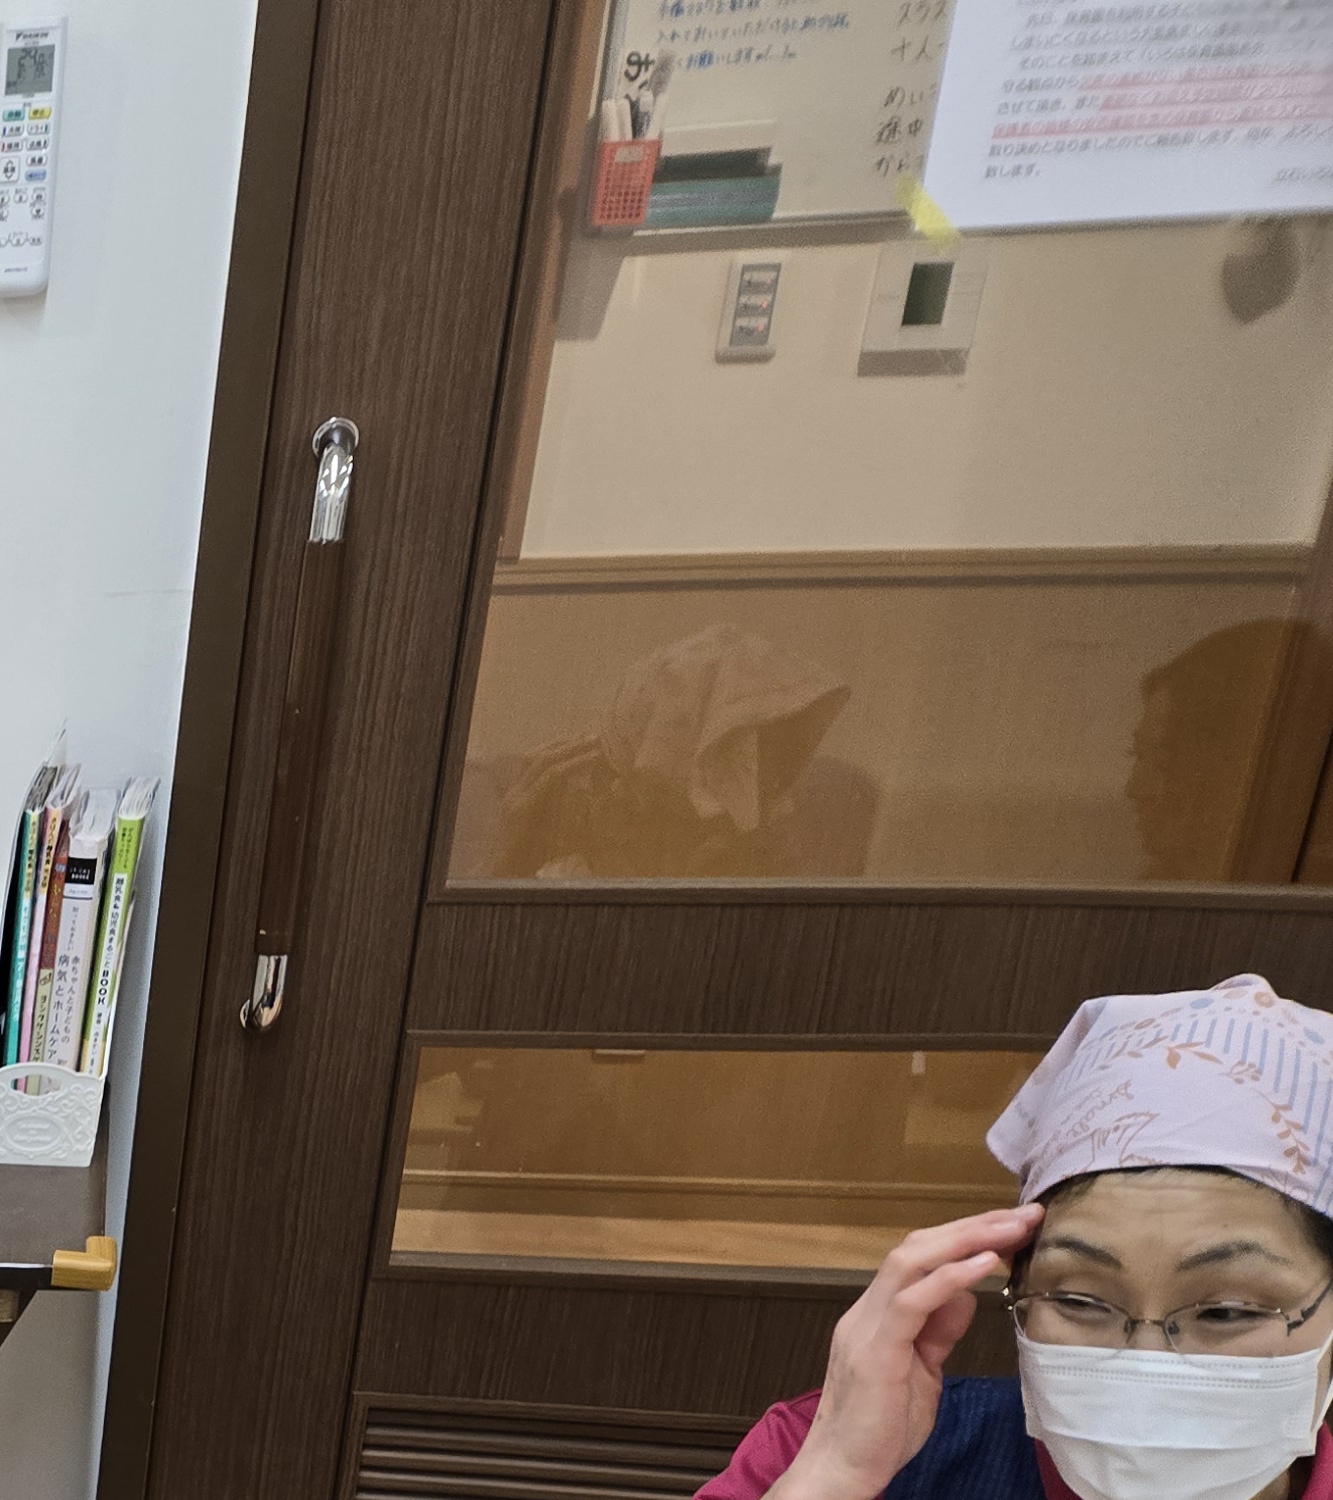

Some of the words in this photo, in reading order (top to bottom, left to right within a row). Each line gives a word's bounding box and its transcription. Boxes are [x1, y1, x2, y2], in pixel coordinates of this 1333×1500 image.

[47, 954, 70, 1060] 病気とホームケア
